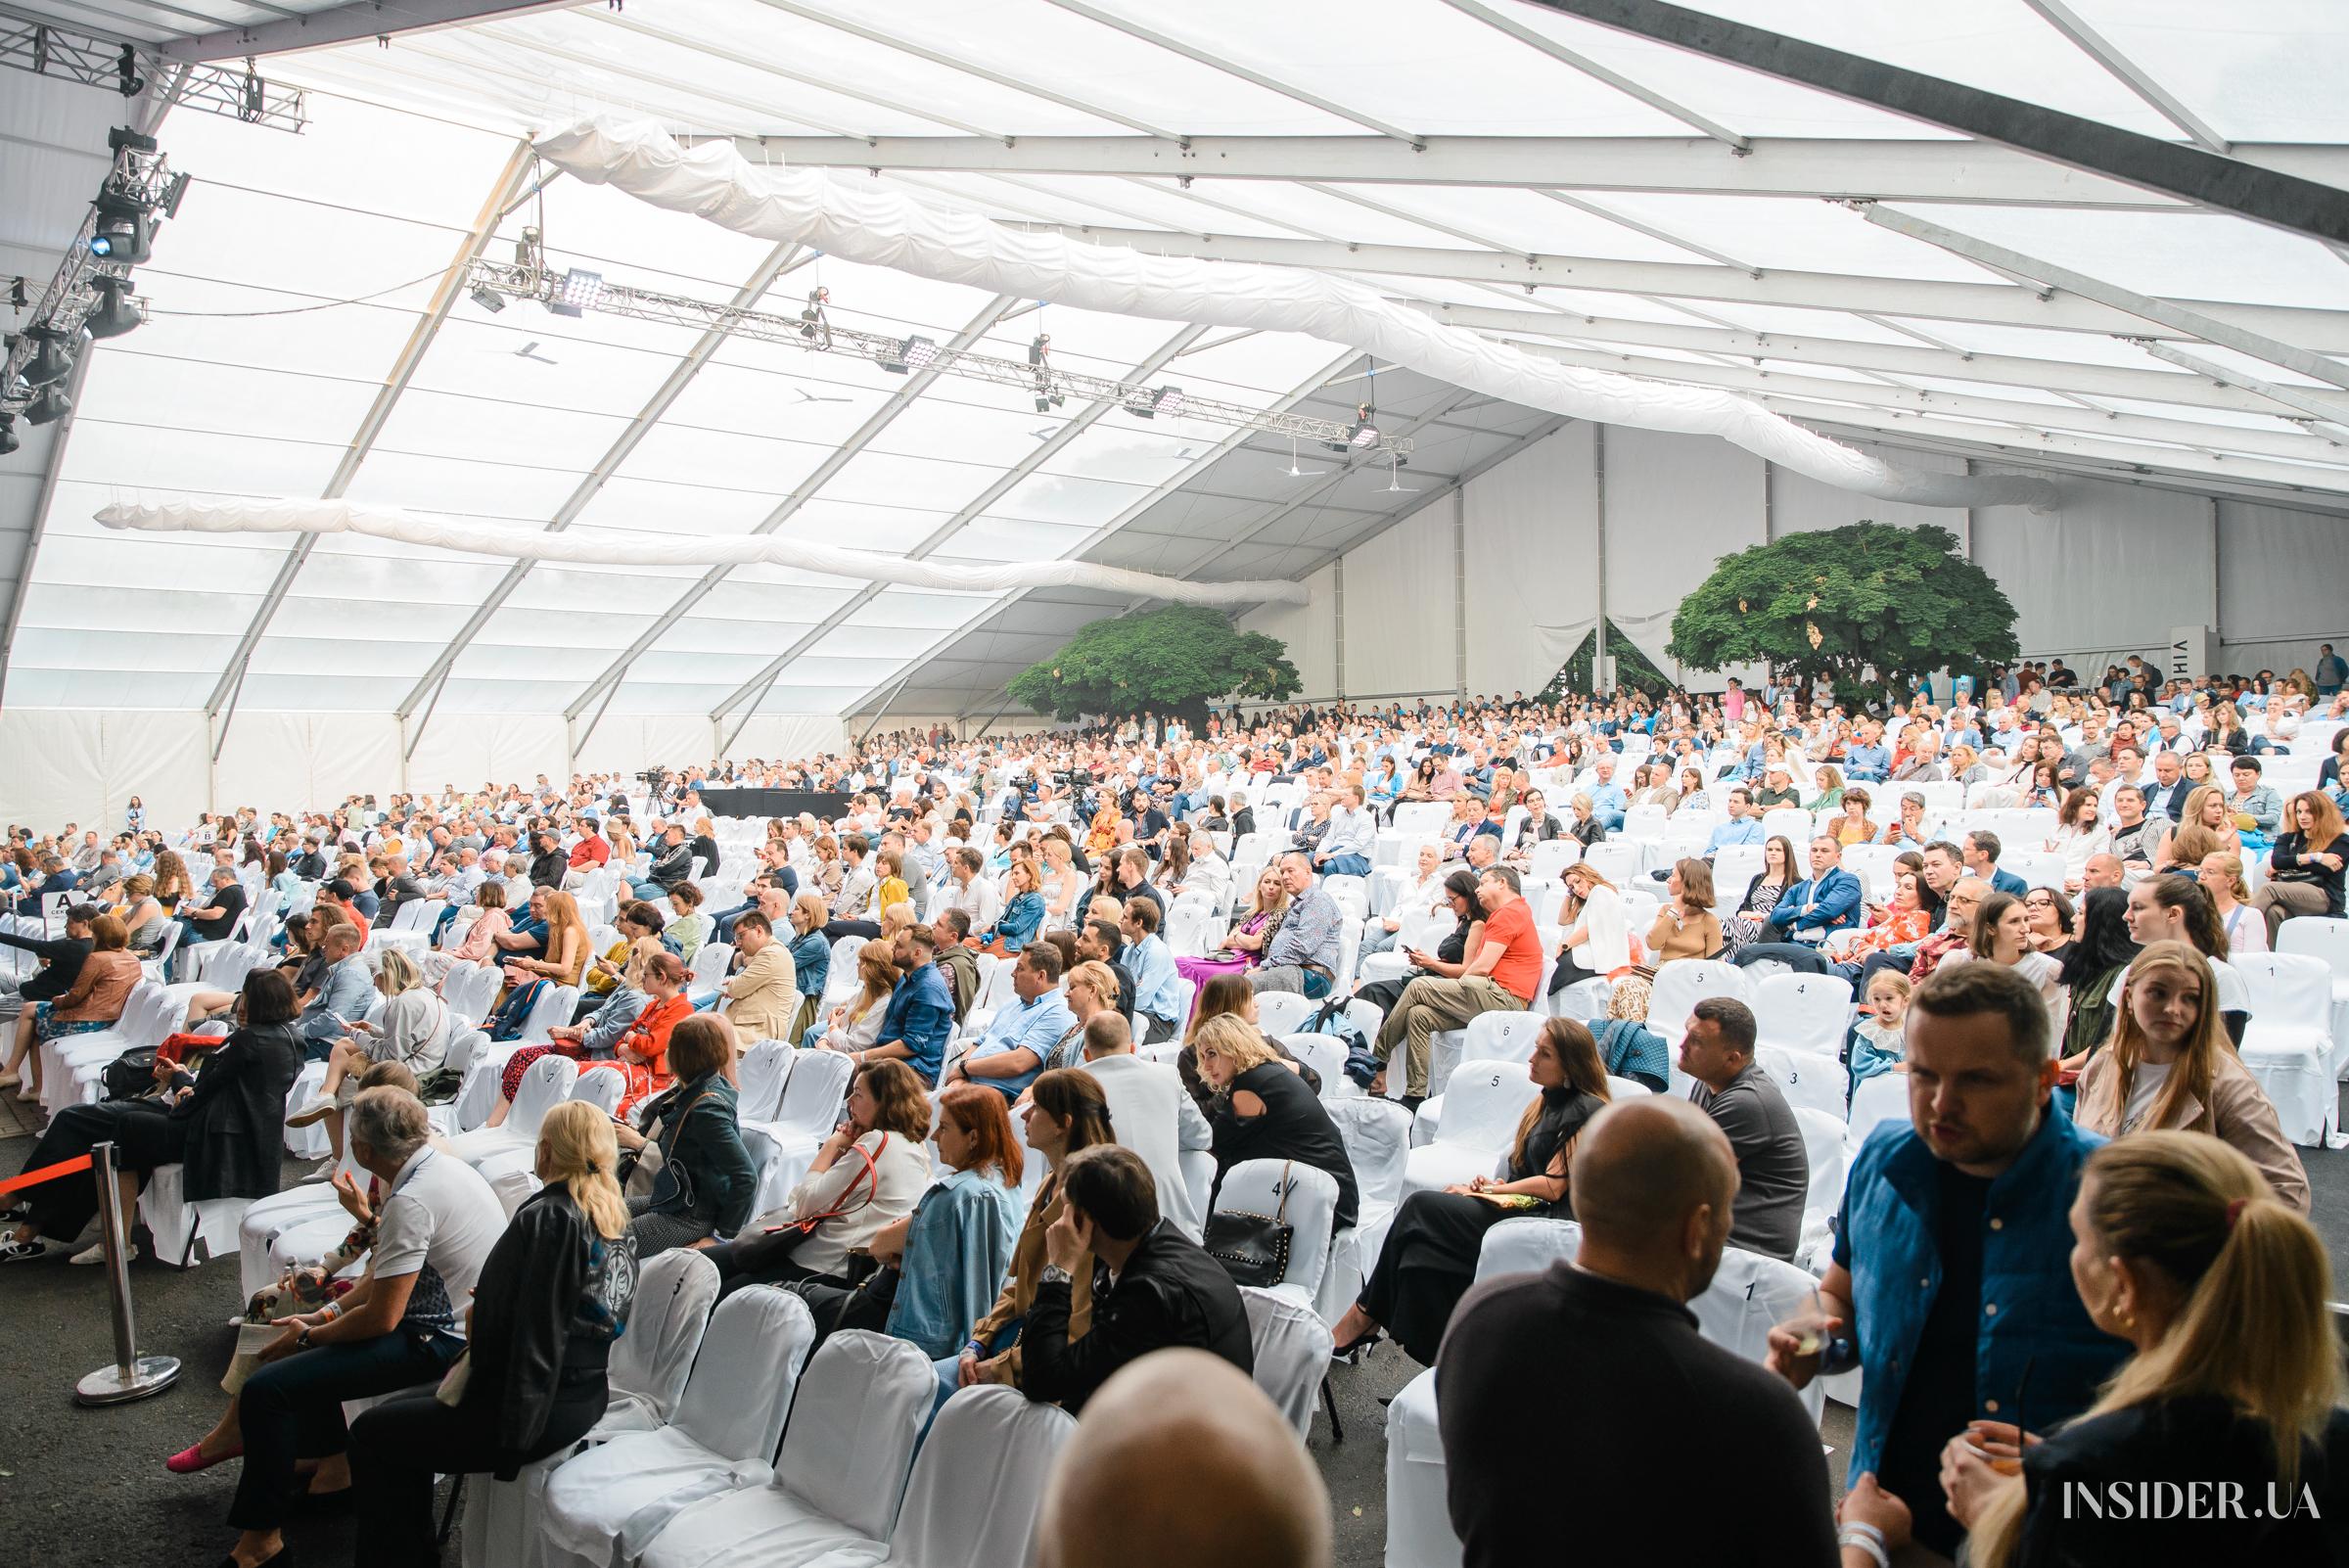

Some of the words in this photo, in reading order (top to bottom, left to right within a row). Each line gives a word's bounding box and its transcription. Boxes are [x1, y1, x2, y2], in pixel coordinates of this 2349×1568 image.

[56, 894, 73, 908] A
[2328, 925, 2334, 934] 1
[2268, 966, 2275, 977] 1
[1697, 972, 1704, 983] 5
[1797, 984, 1805, 994] 4
[1275, 1001, 1282, 1010] 9
[1345, 1010, 1352, 1020] 8
[1502, 1026, 1510, 1037] 6
[1308, 1045, 1314, 1056] 7
[1491, 1075, 1500, 1087] 5
[1789, 1072, 1798, 1084] 3
[1271, 1181, 1281, 1196] 4
[1745, 1282, 1755, 1301] 1
